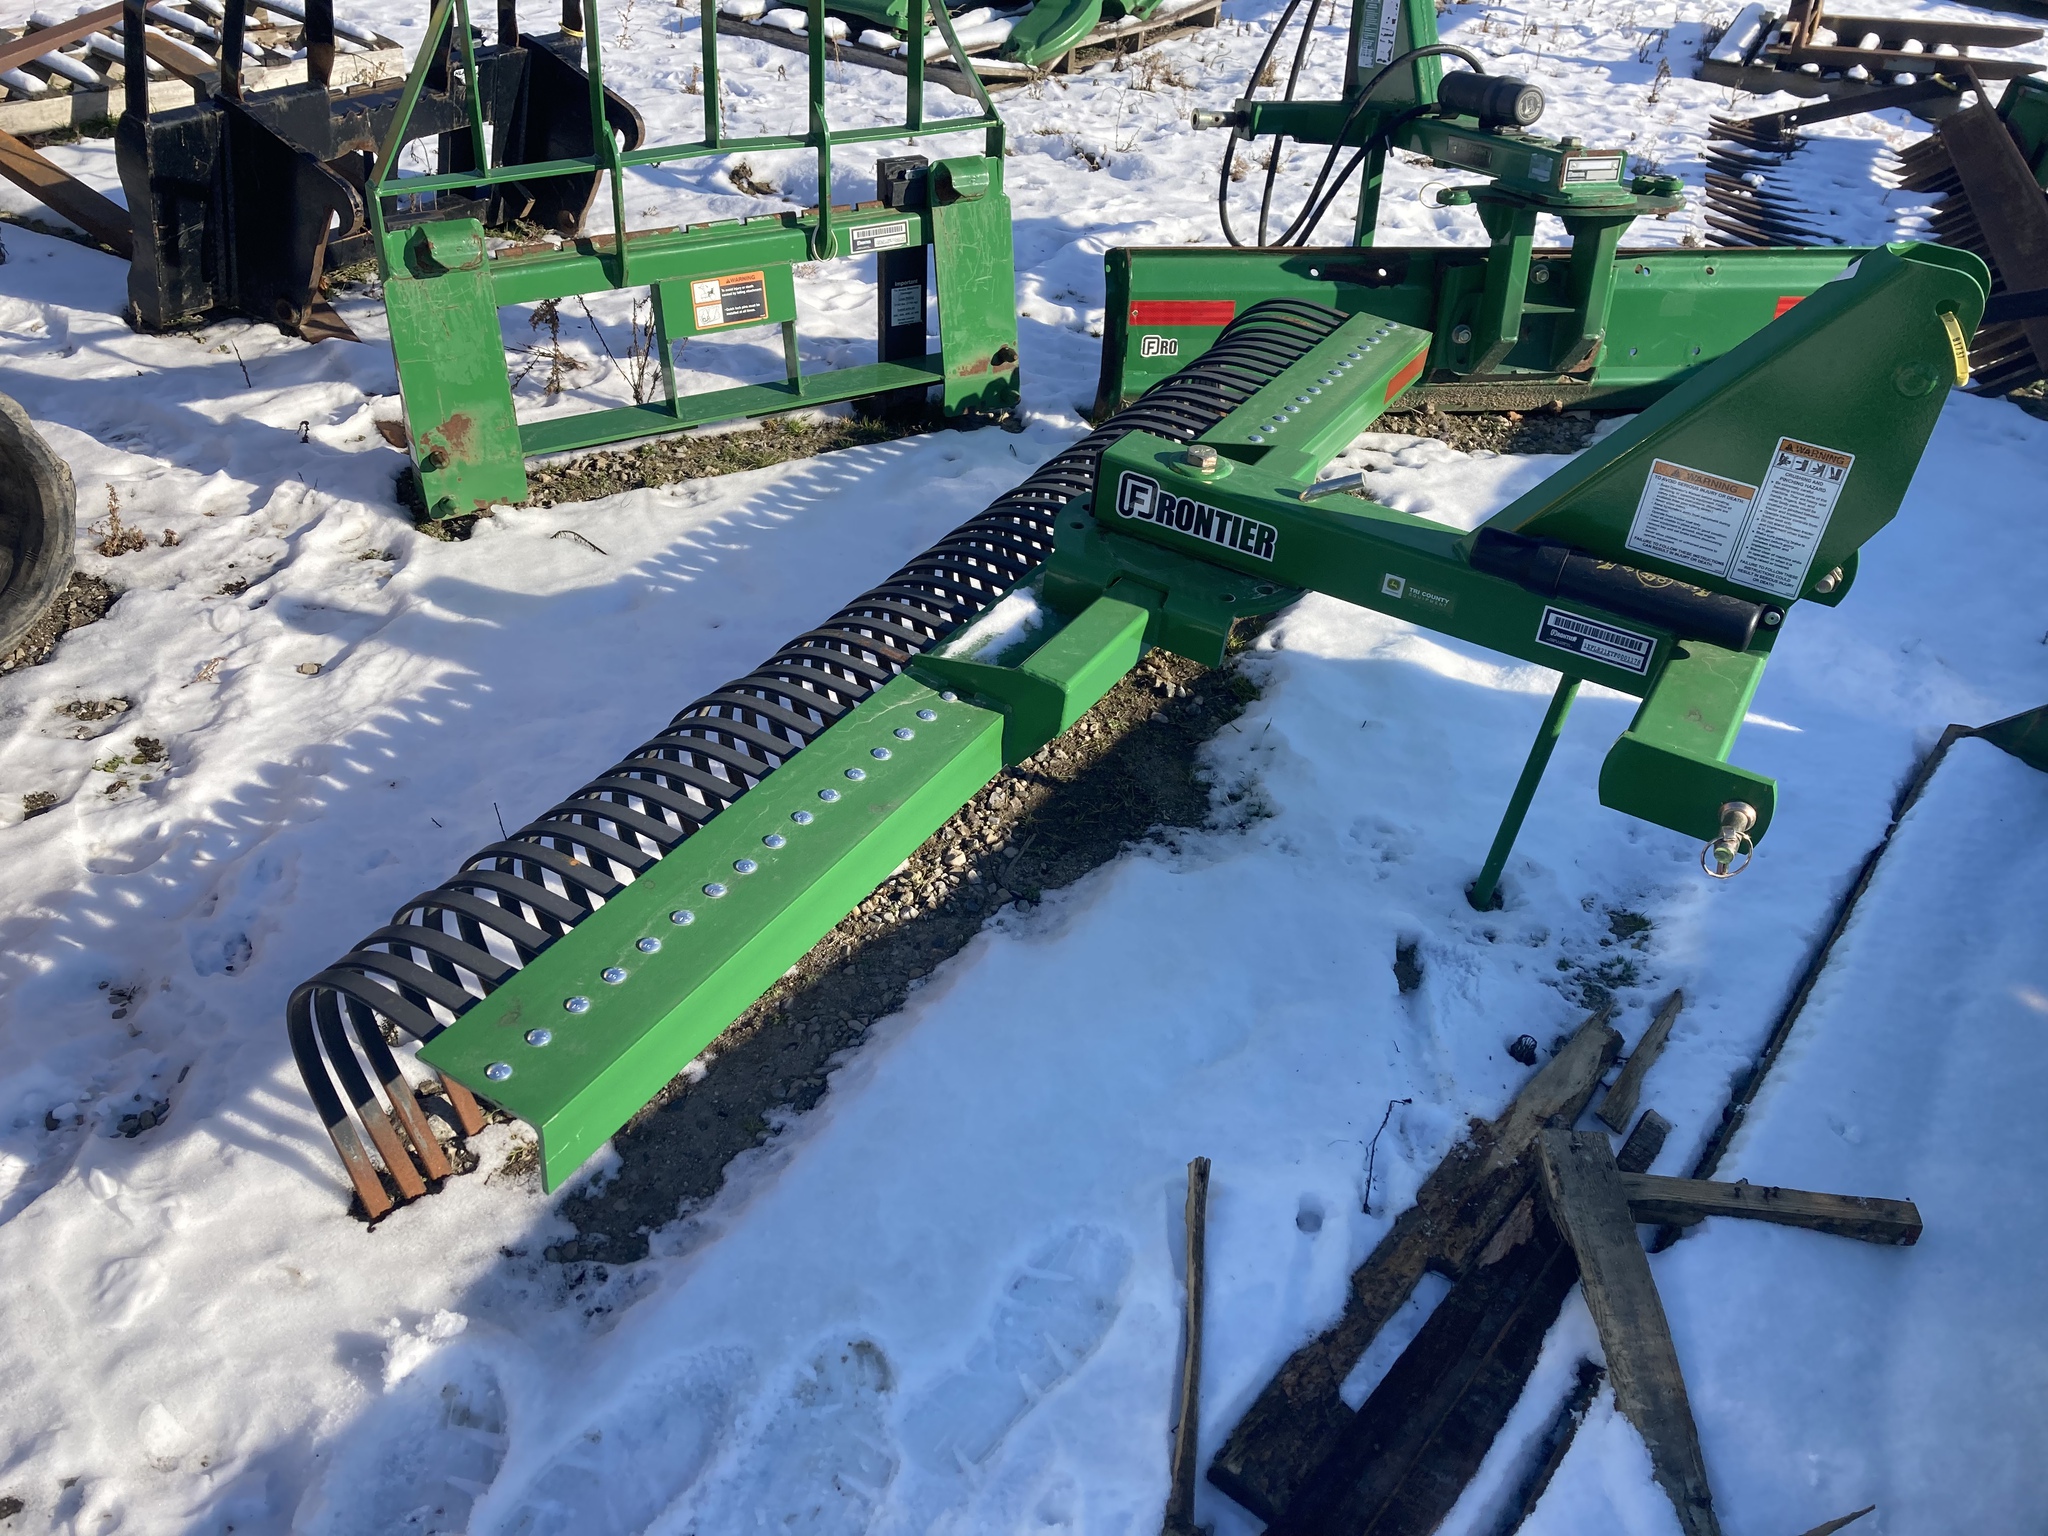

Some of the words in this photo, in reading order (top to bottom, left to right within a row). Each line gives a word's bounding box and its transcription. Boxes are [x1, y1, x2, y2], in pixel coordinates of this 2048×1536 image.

[731, 275, 755, 283] WARNING
[1794, 445, 1846, 465] WARNING
[1686, 473, 1739, 494] WARNING
[1779, 476, 1804, 487] PINCHING
[1804, 483, 1827, 493] HAZARD
[1784, 472, 1812, 483] CRUSHING
[1677, 482, 1699, 491] SERIOUS
[1699, 488, 1717, 496] INJURY
[1118, 472, 1275, 560] FRONTIER
[1408, 593, 1447, 607] EQUIPMENT
[1409, 587, 1420, 595] TRI
[1422, 591, 1450, 604] COUNTY
